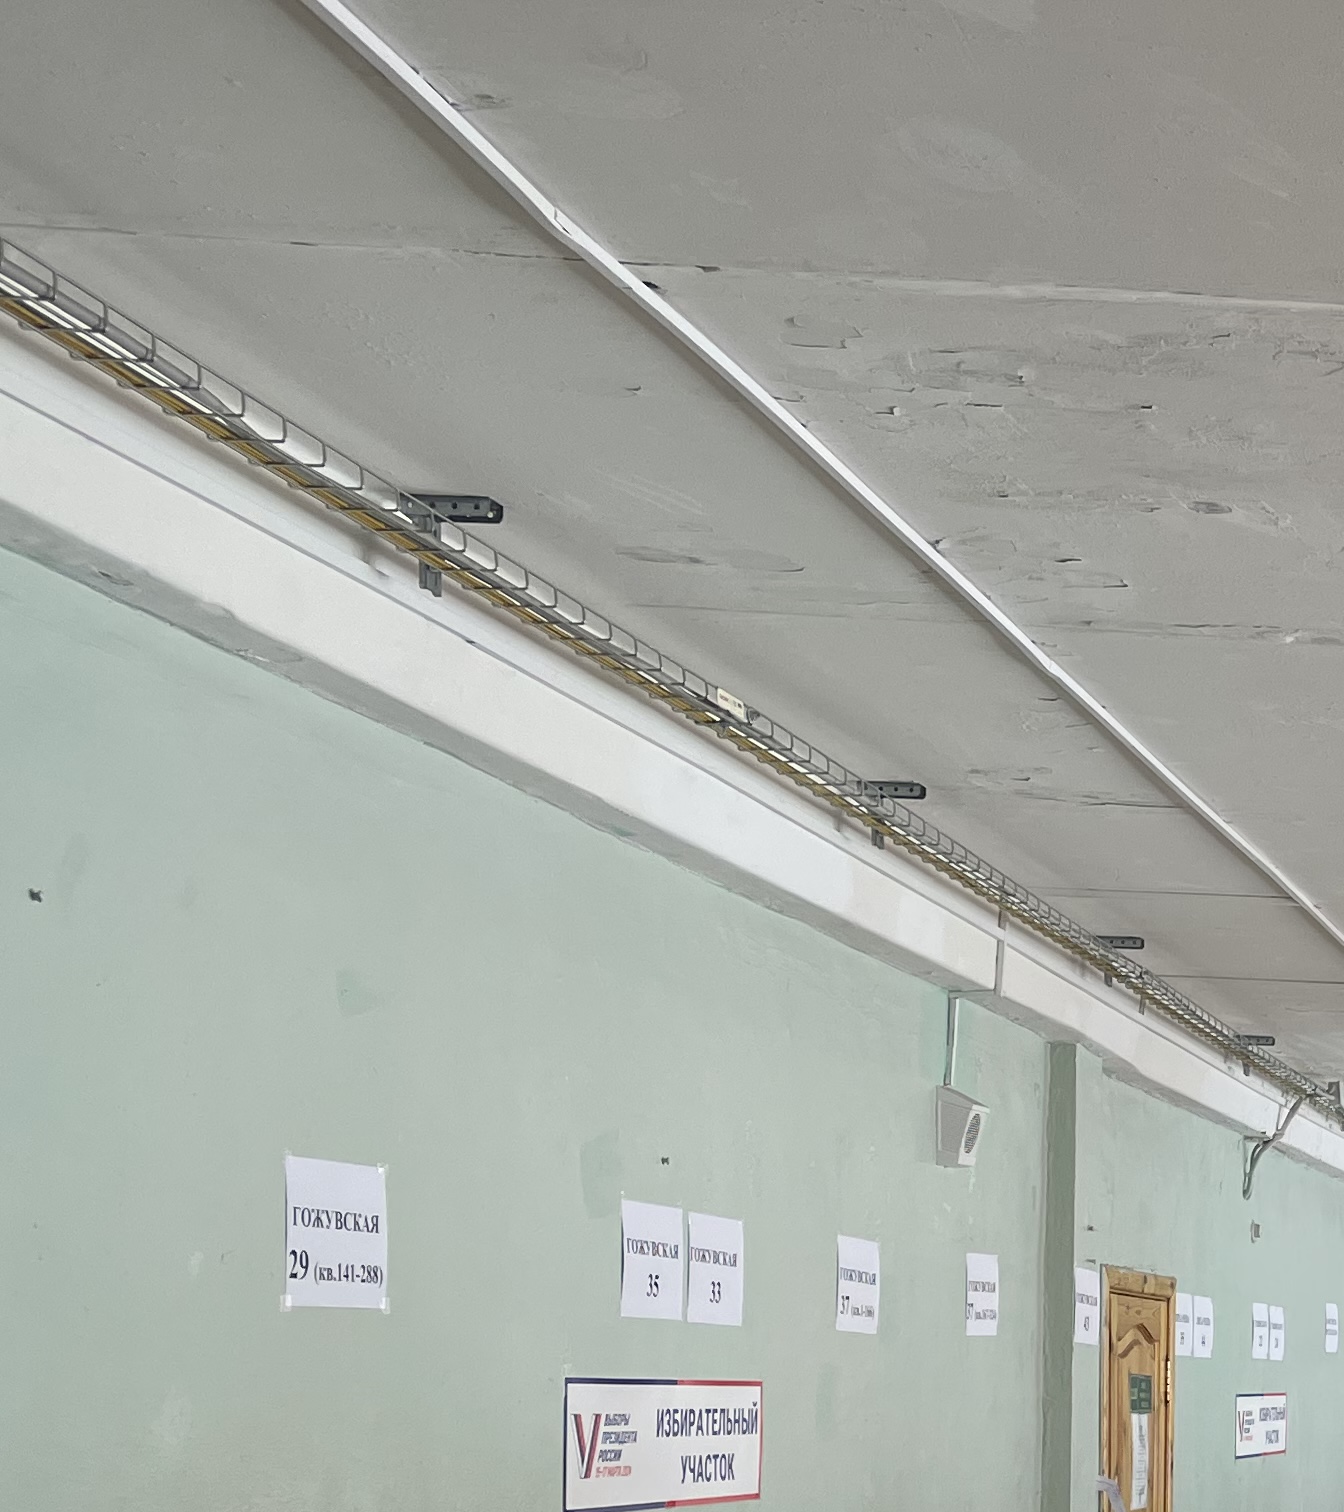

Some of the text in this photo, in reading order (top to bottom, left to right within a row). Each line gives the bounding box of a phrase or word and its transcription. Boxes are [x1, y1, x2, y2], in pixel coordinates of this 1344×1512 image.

[293, 1206, 380, 1234] ГОЖУВСКАЯ
[626, 1237, 679, 1260] ГОЖУВСКАЯ
[689, 1246, 738, 1268] ГОЖУВСКАЯ
[289, 1249, 384, 1288] 29 (кв.141-288)
[646, 1273, 660, 1298] 35
[709, 1280, 722, 1304] 33
[840, 1295, 850, 1315] 37
[656, 1401, 759, 1438] ИЗБИРАТЕЛЬНЫЙ
[681, 1453, 735, 1484] УЧАСТОК
